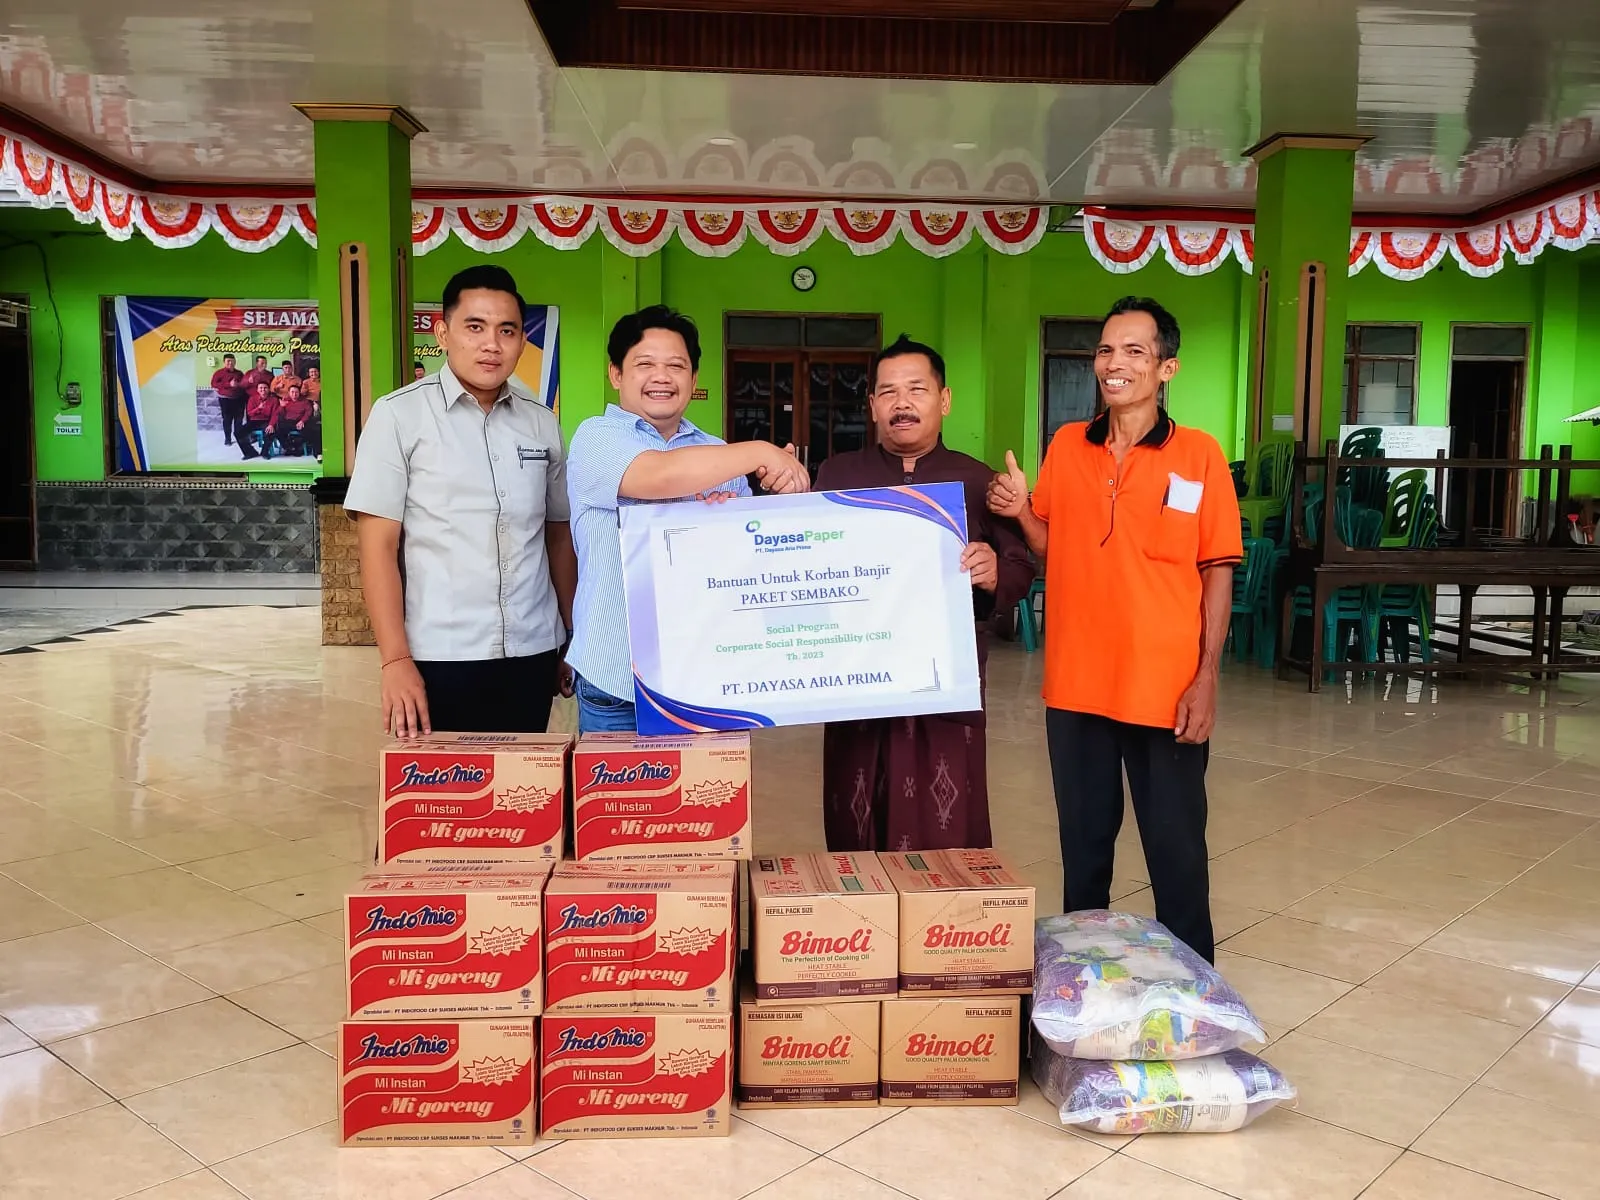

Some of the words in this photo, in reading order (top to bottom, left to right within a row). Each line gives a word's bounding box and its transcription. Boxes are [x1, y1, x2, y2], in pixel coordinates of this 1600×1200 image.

[161, 336, 192, 352] Atas
[197, 336, 284, 356] Pelantikannya
[754, 530, 844, 546] DayasaPaper
[707, 577, 757, 589] Bantuan
[761, 571, 800, 584] Untuk
[805, 568, 849, 581] Korban
[854, 565, 891, 580] Banjir
[741, 592, 787, 604] PAKET
[791, 586, 859, 601] SEMBAKO
[767, 625, 794, 634] Social
[798, 623, 839, 633] Program
[716, 643, 762, 653] Corporate
[766, 639, 793, 649] Social
[796, 634, 863, 648] Responsibility
[866, 631, 891, 642] (CSR)
[787, 653, 800, 661] Th.
[722, 684, 743, 695] PT.
[749, 678, 805, 693] DAYASA
[810, 676, 842, 688] ARIA
[848, 672, 892, 684] PRIMA
[415, 804, 427, 814] Mi
[430, 804, 462, 814] Instan
[605, 802, 617, 812] Mi
[620, 802, 651, 812] Instan
[420, 822, 454, 838] Mi
[454, 826, 526, 843] goreng
[611, 820, 642, 835] Mi
[644, 821, 713, 839] goreng
[780, 929, 872, 955] Bimoli
[924, 923, 1012, 948] Bimoli
[382, 950, 395, 960] Mi
[399, 949, 434, 960] Instan
[575, 948, 588, 957] Mi
[591, 948, 625, 957] Instan
[389, 969, 423, 987] Mi
[424, 971, 502, 989] goreng
[581, 966, 616, 982] Mi
[618, 967, 690, 986] goreng
[761, 1035, 852, 1059] Bimoli
[905, 1033, 995, 1056] Bimoli
[376, 1078, 388, 1088] Mi
[392, 1078, 426, 1088] Instan
[573, 1070, 586, 1080] Mi
[589, 1070, 622, 1080] Instan
[381, 1097, 417, 1114] Mi
[417, 1100, 494, 1118] goreng
[579, 1088, 614, 1105] Mi
[613, 1091, 689, 1110] goreng
